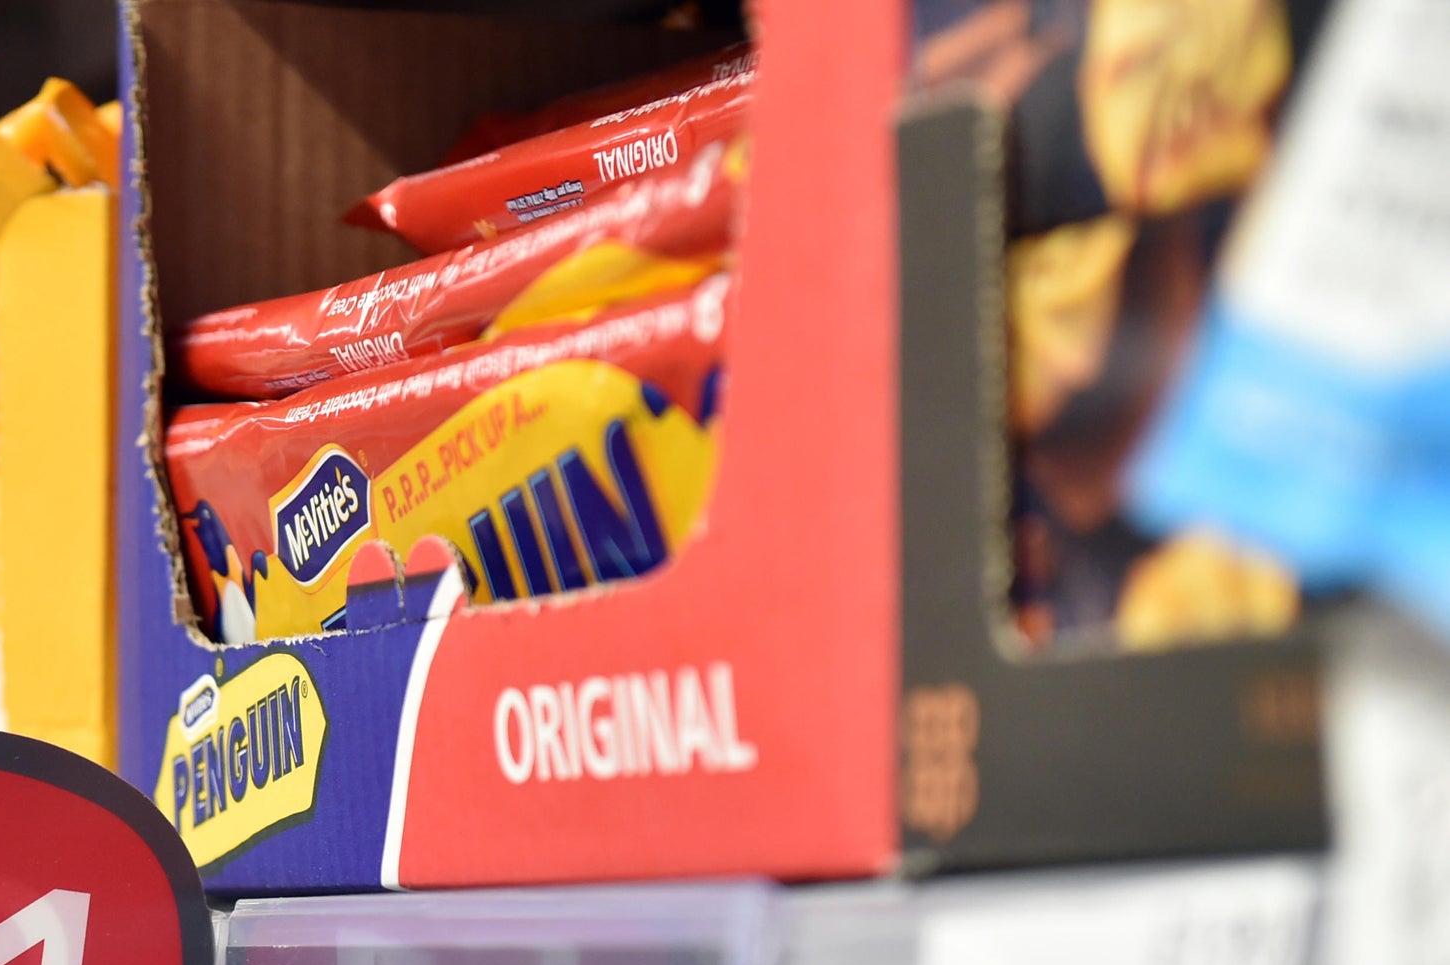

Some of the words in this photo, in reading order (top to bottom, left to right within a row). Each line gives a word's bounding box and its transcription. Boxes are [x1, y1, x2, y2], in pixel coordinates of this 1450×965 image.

[593, 130, 678, 183] ORIGINAL
[328, 331, 405, 372] ORIGINAL
[285, 400, 322, 424] Cream
[320, 387, 375, 418] Chocolate
[494, 660, 759, 785] ORIGINAL
[172, 675, 305, 834] PENGUIN
